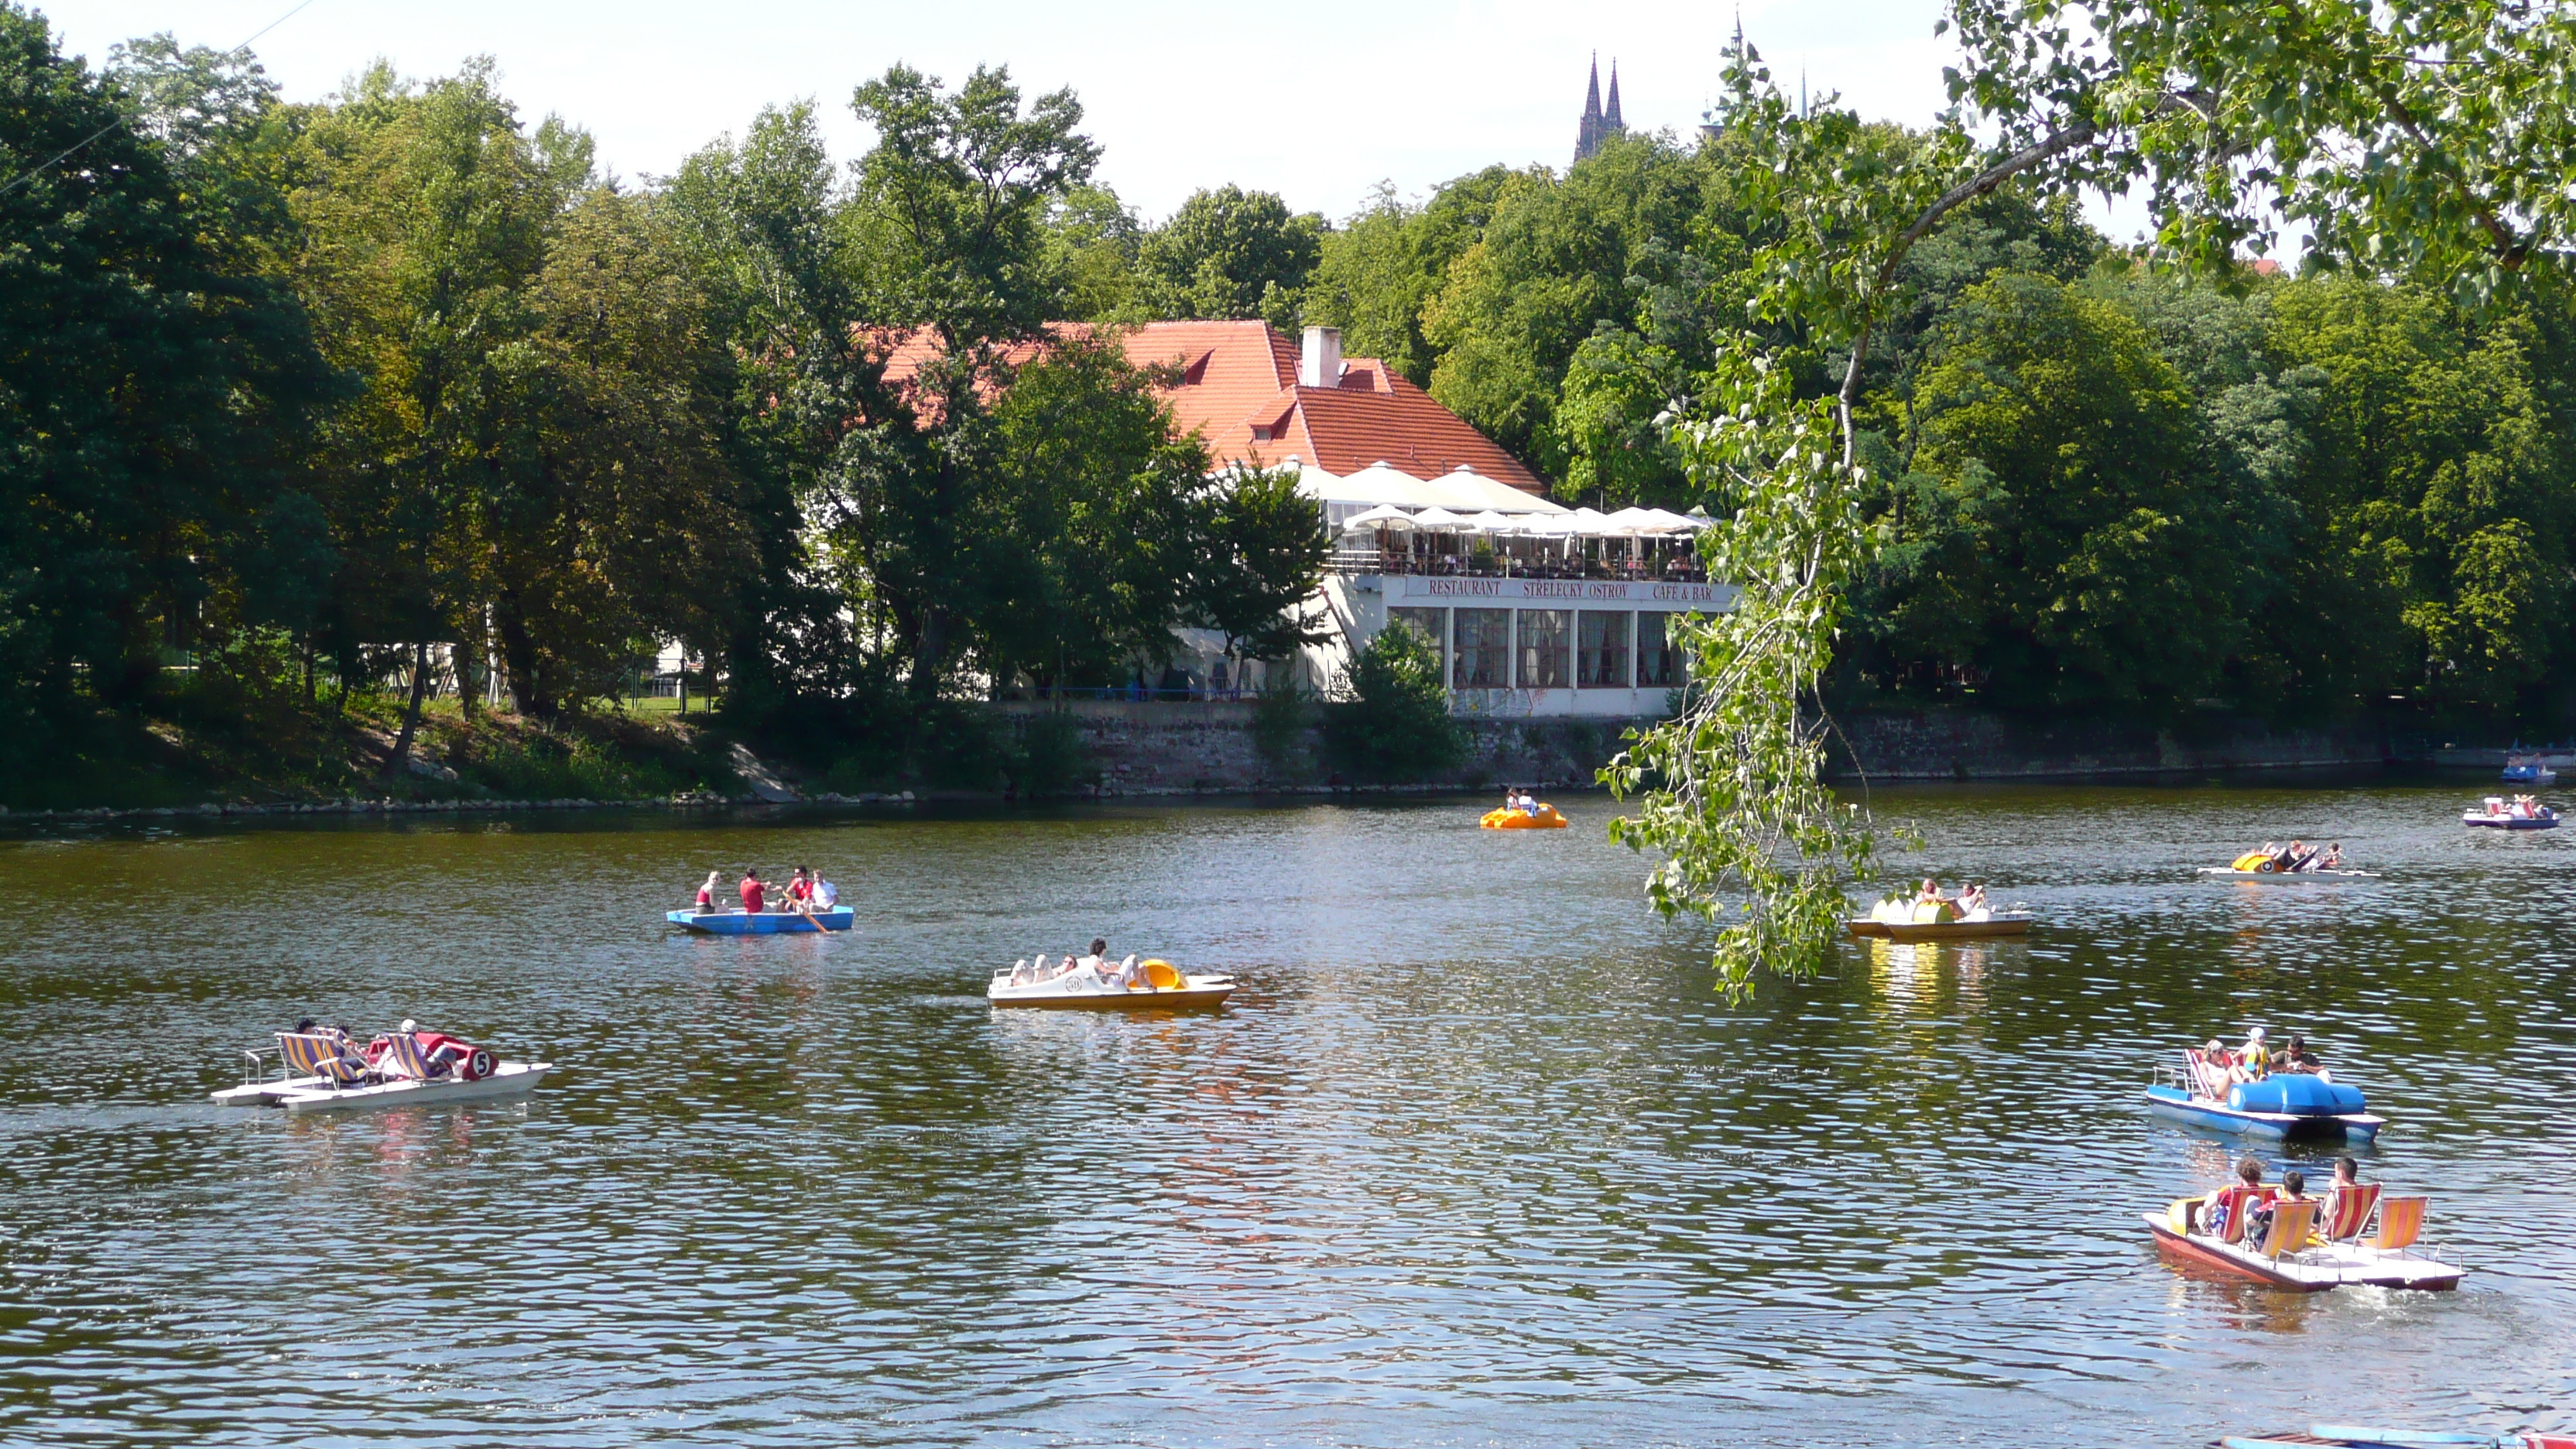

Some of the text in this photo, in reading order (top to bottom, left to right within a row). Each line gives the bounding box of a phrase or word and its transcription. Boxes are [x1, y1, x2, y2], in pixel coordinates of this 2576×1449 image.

[1429, 580, 1712, 601] RESTAURANT STŘELECKÝ OSTROV CAFÉ & BAR
[477, 1053, 487, 1074] 5
